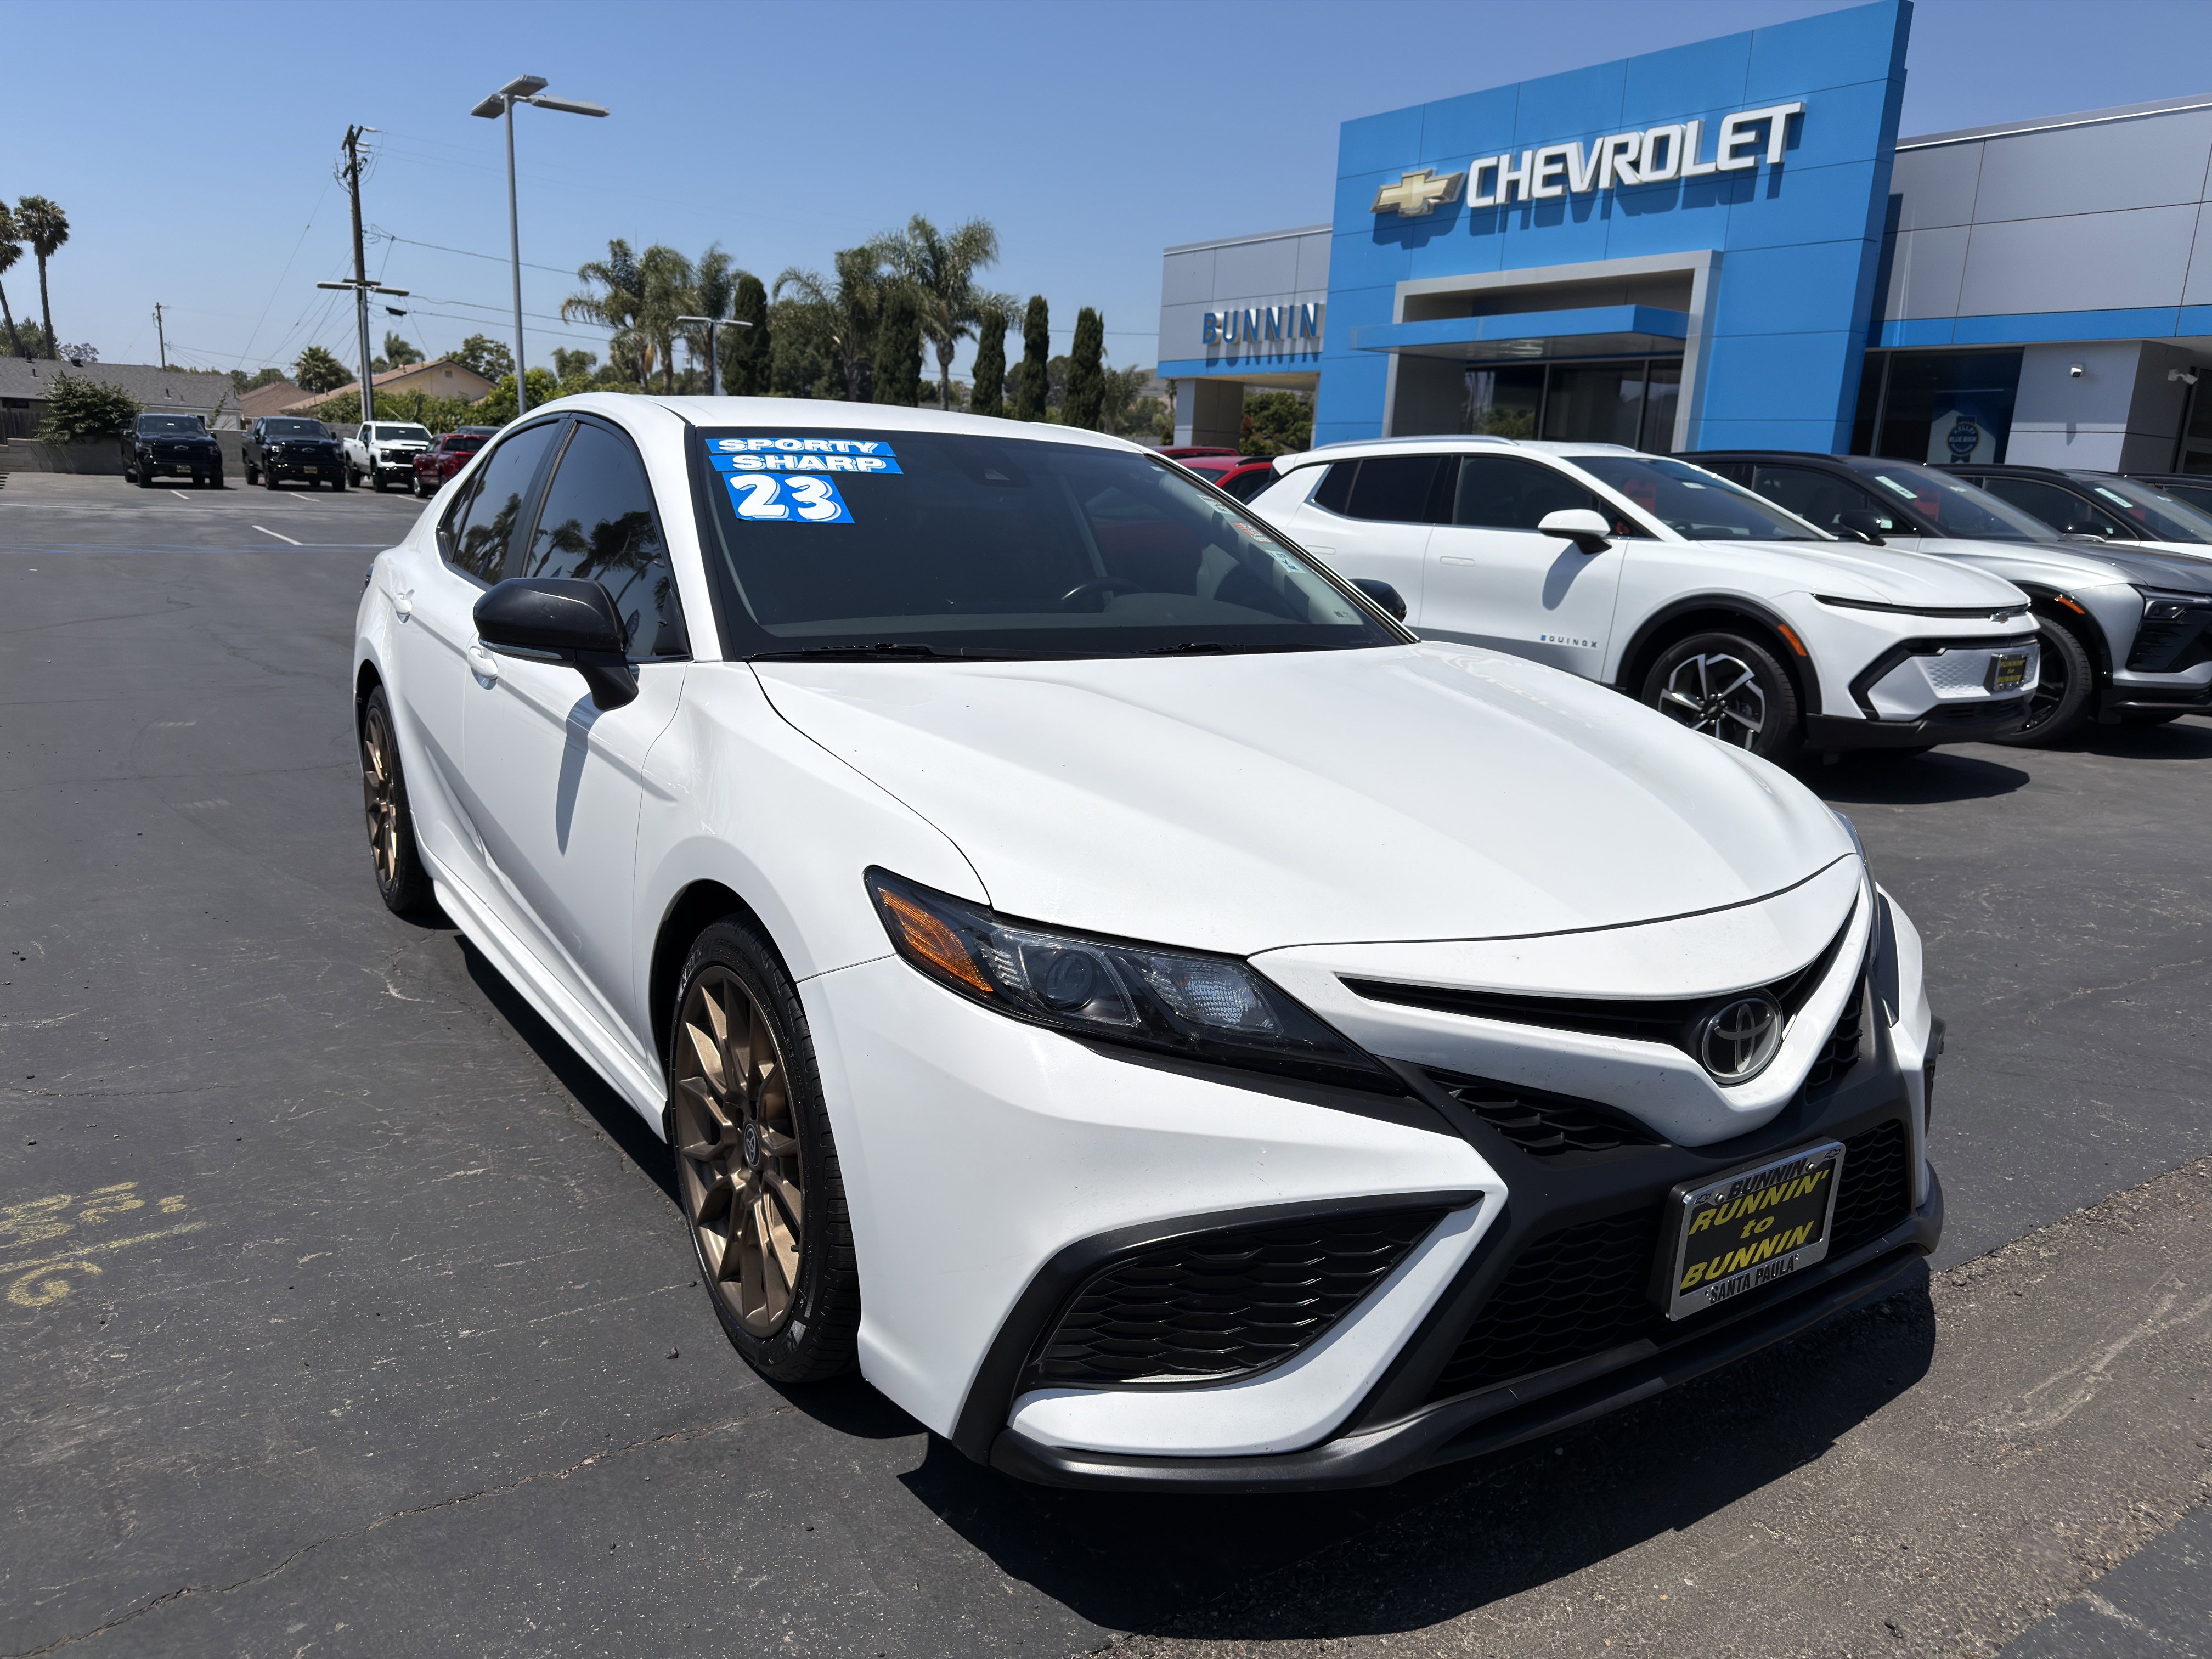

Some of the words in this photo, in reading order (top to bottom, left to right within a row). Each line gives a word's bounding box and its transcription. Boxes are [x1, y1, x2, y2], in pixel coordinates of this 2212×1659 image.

[1466, 101, 1806, 207] CHEVROLET
[1203, 303, 1325, 345] BUNNIN
[718, 439, 879, 453] SPORTY
[732, 455, 887, 471] SHARP
[730, 474, 842, 521] 23
[1541, 635, 1597, 648] EQUINOX
[1727, 1157, 1808, 1200] BUNNIN
[1687, 1169, 1830, 1235] RUNNIN'
[1740, 1216, 1775, 1239] to
[1680, 1221, 1814, 1290] BUNNIN
[1709, 1272, 1751, 1304] SANTA
[1755, 1255, 1794, 1285] PAULA
